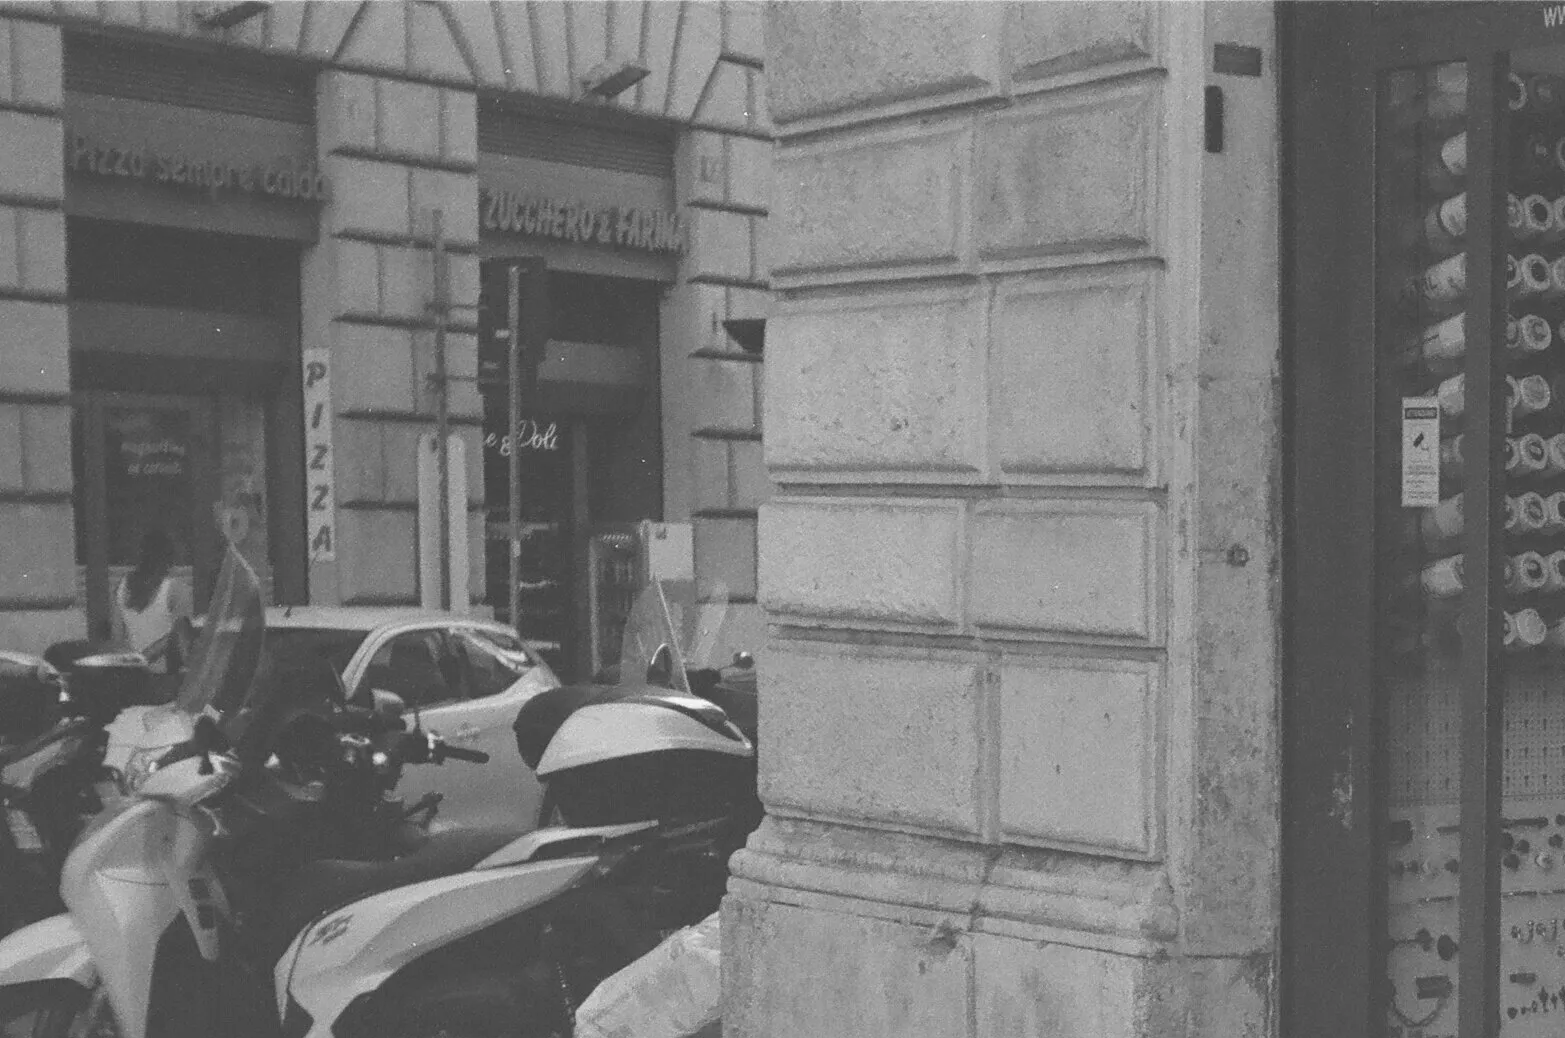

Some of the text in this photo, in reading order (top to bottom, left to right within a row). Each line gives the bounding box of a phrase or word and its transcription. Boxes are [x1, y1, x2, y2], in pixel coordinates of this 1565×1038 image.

[156, 154, 255, 201] sempre
[483, 189, 594, 243] ZUCCHERO
[306, 361, 331, 552] PIZZA
